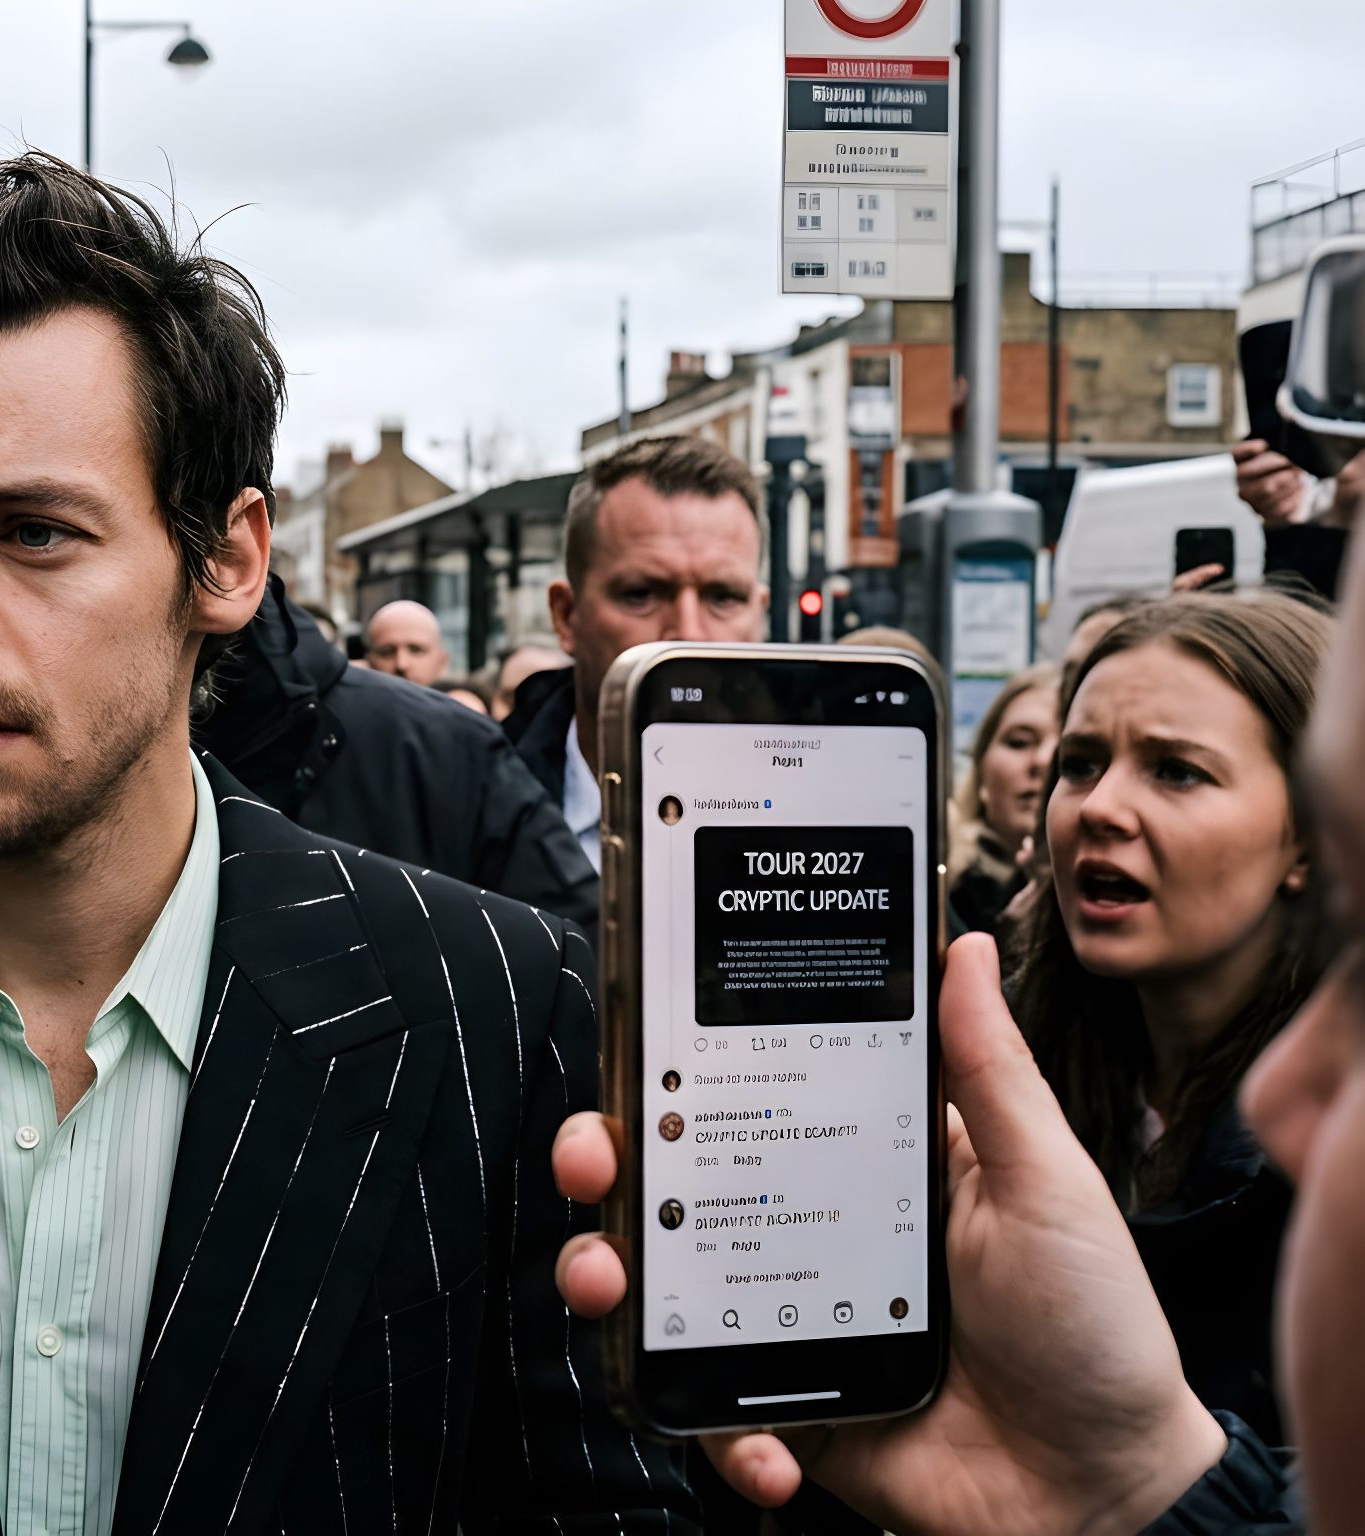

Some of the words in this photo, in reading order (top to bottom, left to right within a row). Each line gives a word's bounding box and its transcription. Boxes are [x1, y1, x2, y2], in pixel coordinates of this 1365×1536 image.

[743, 851, 806, 875] TOUR
[810, 851, 865, 875] 2027
[718, 889, 805, 912] CRYPTIC
[809, 888, 890, 911] UPDATE
